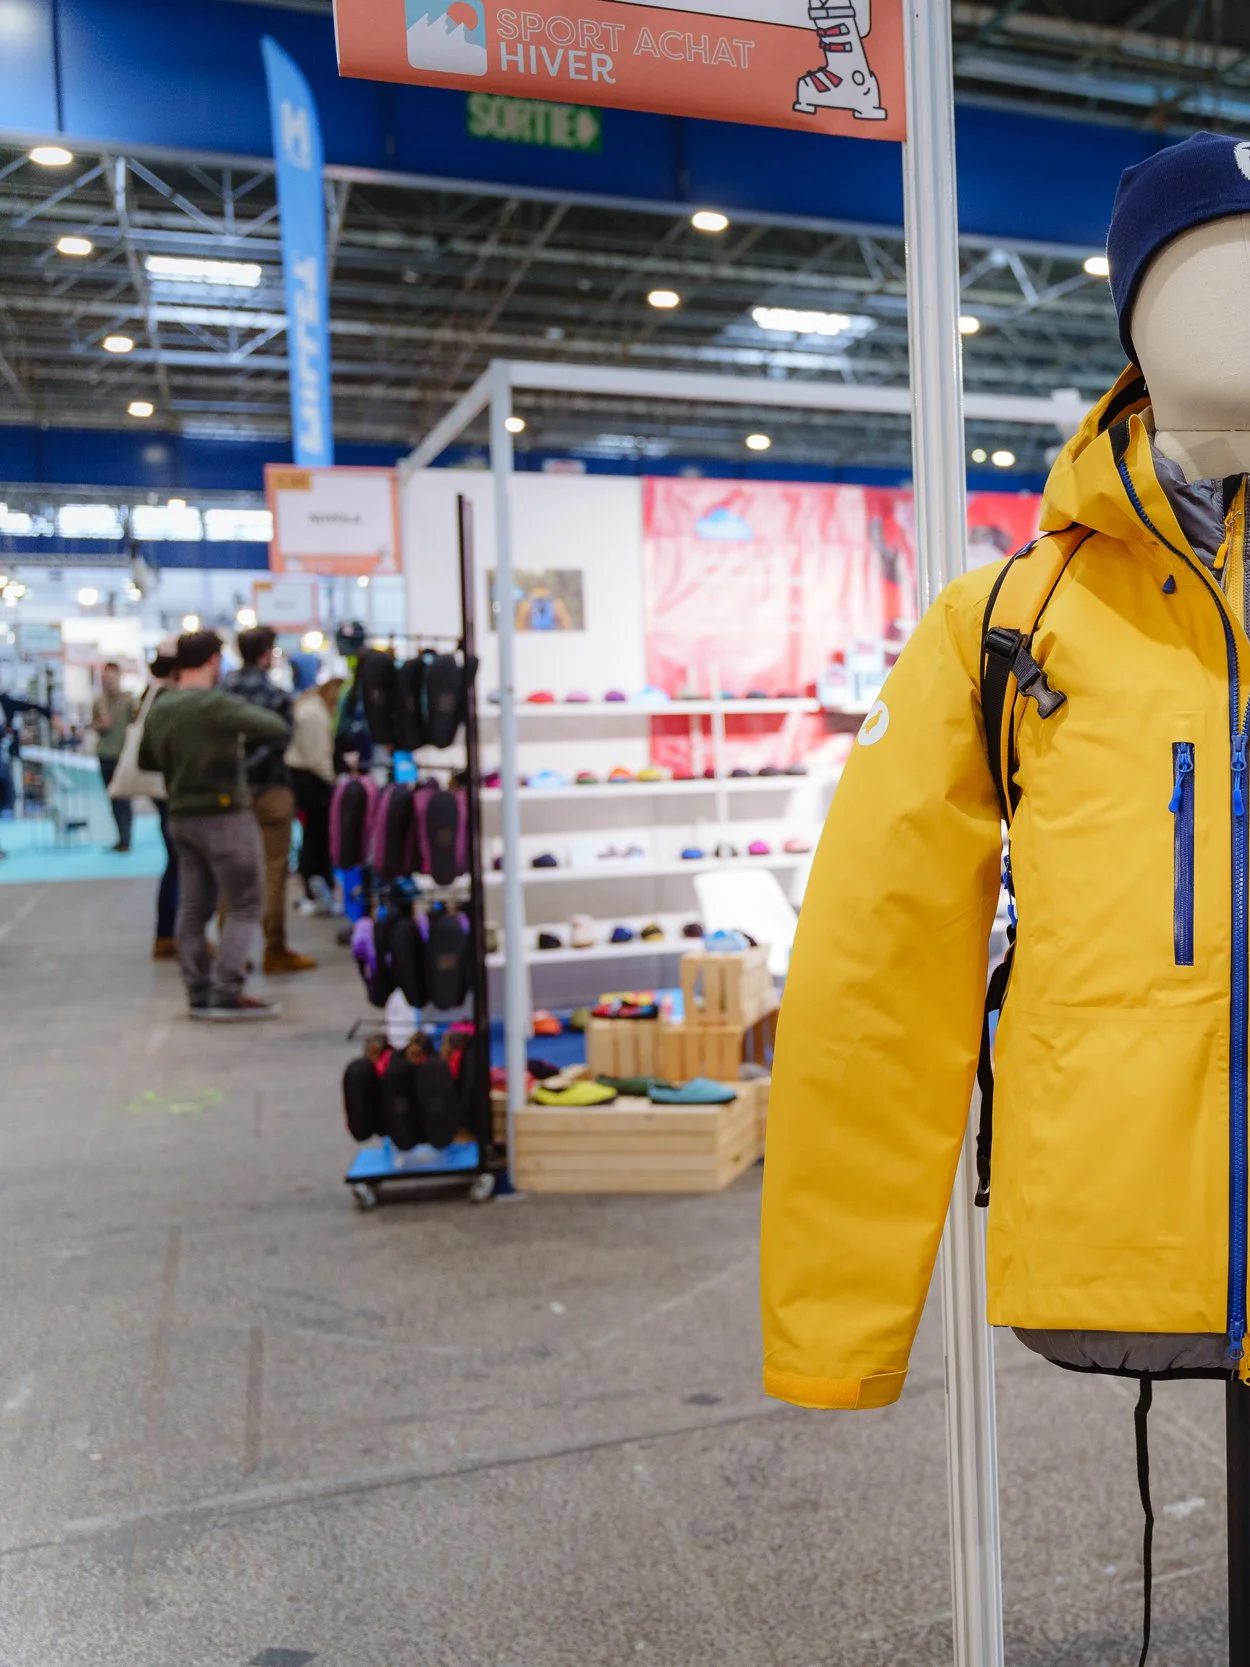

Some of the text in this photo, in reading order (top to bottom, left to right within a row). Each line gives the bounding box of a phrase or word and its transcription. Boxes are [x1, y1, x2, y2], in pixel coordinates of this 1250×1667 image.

[497, 9, 755, 69] SPORT ACHAT
[500, 42, 616, 84] HIVER
[469, 93, 577, 148] SORTIE
